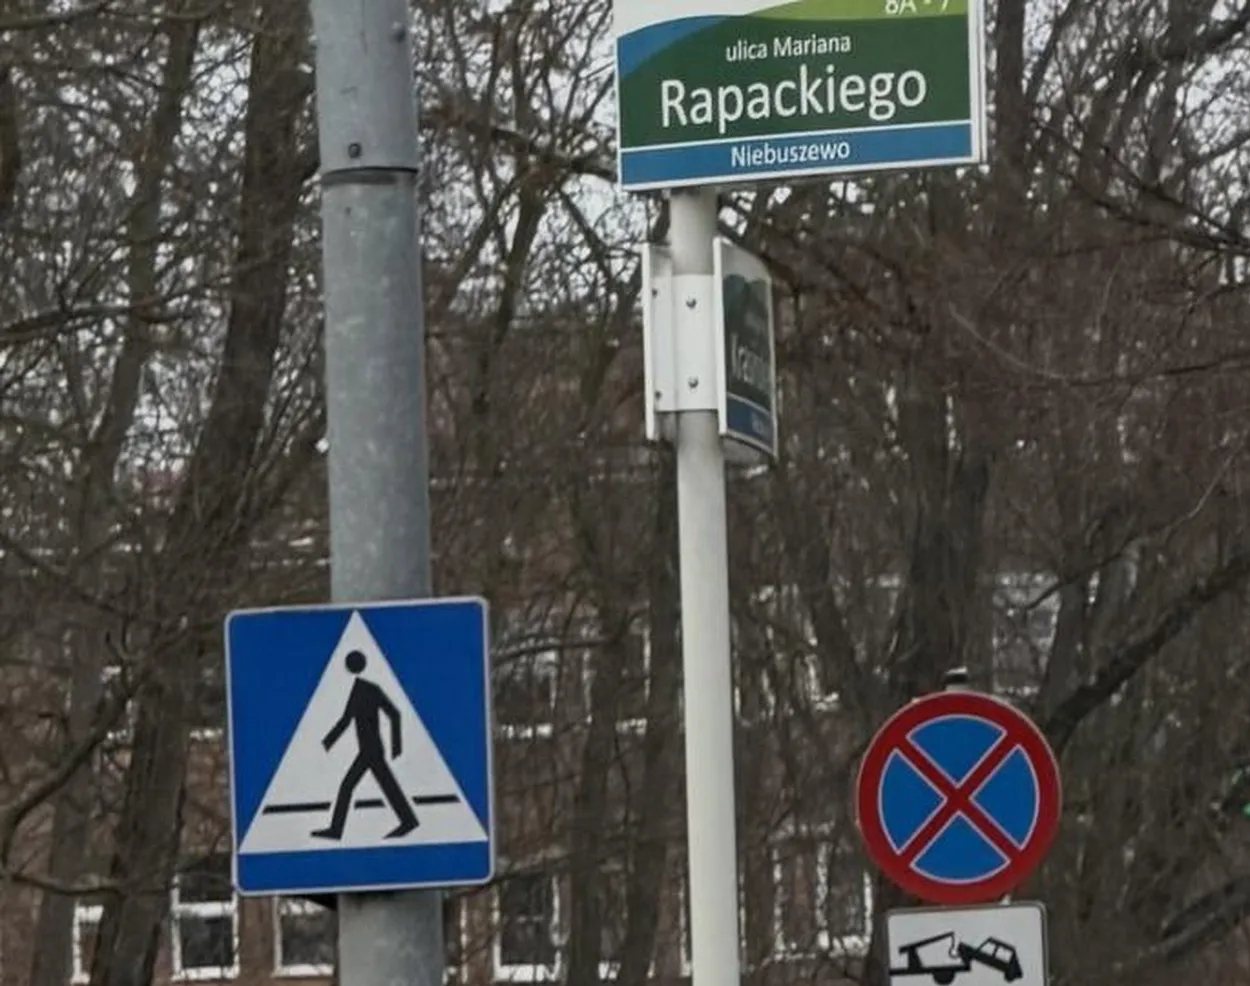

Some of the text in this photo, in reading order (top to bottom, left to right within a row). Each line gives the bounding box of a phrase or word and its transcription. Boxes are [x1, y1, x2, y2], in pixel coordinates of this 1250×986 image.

[725, 33, 852, 62] ulica Mariana
[661, 64, 927, 134] Rapackiego
[730, 138, 851, 167] Niebuszewo
